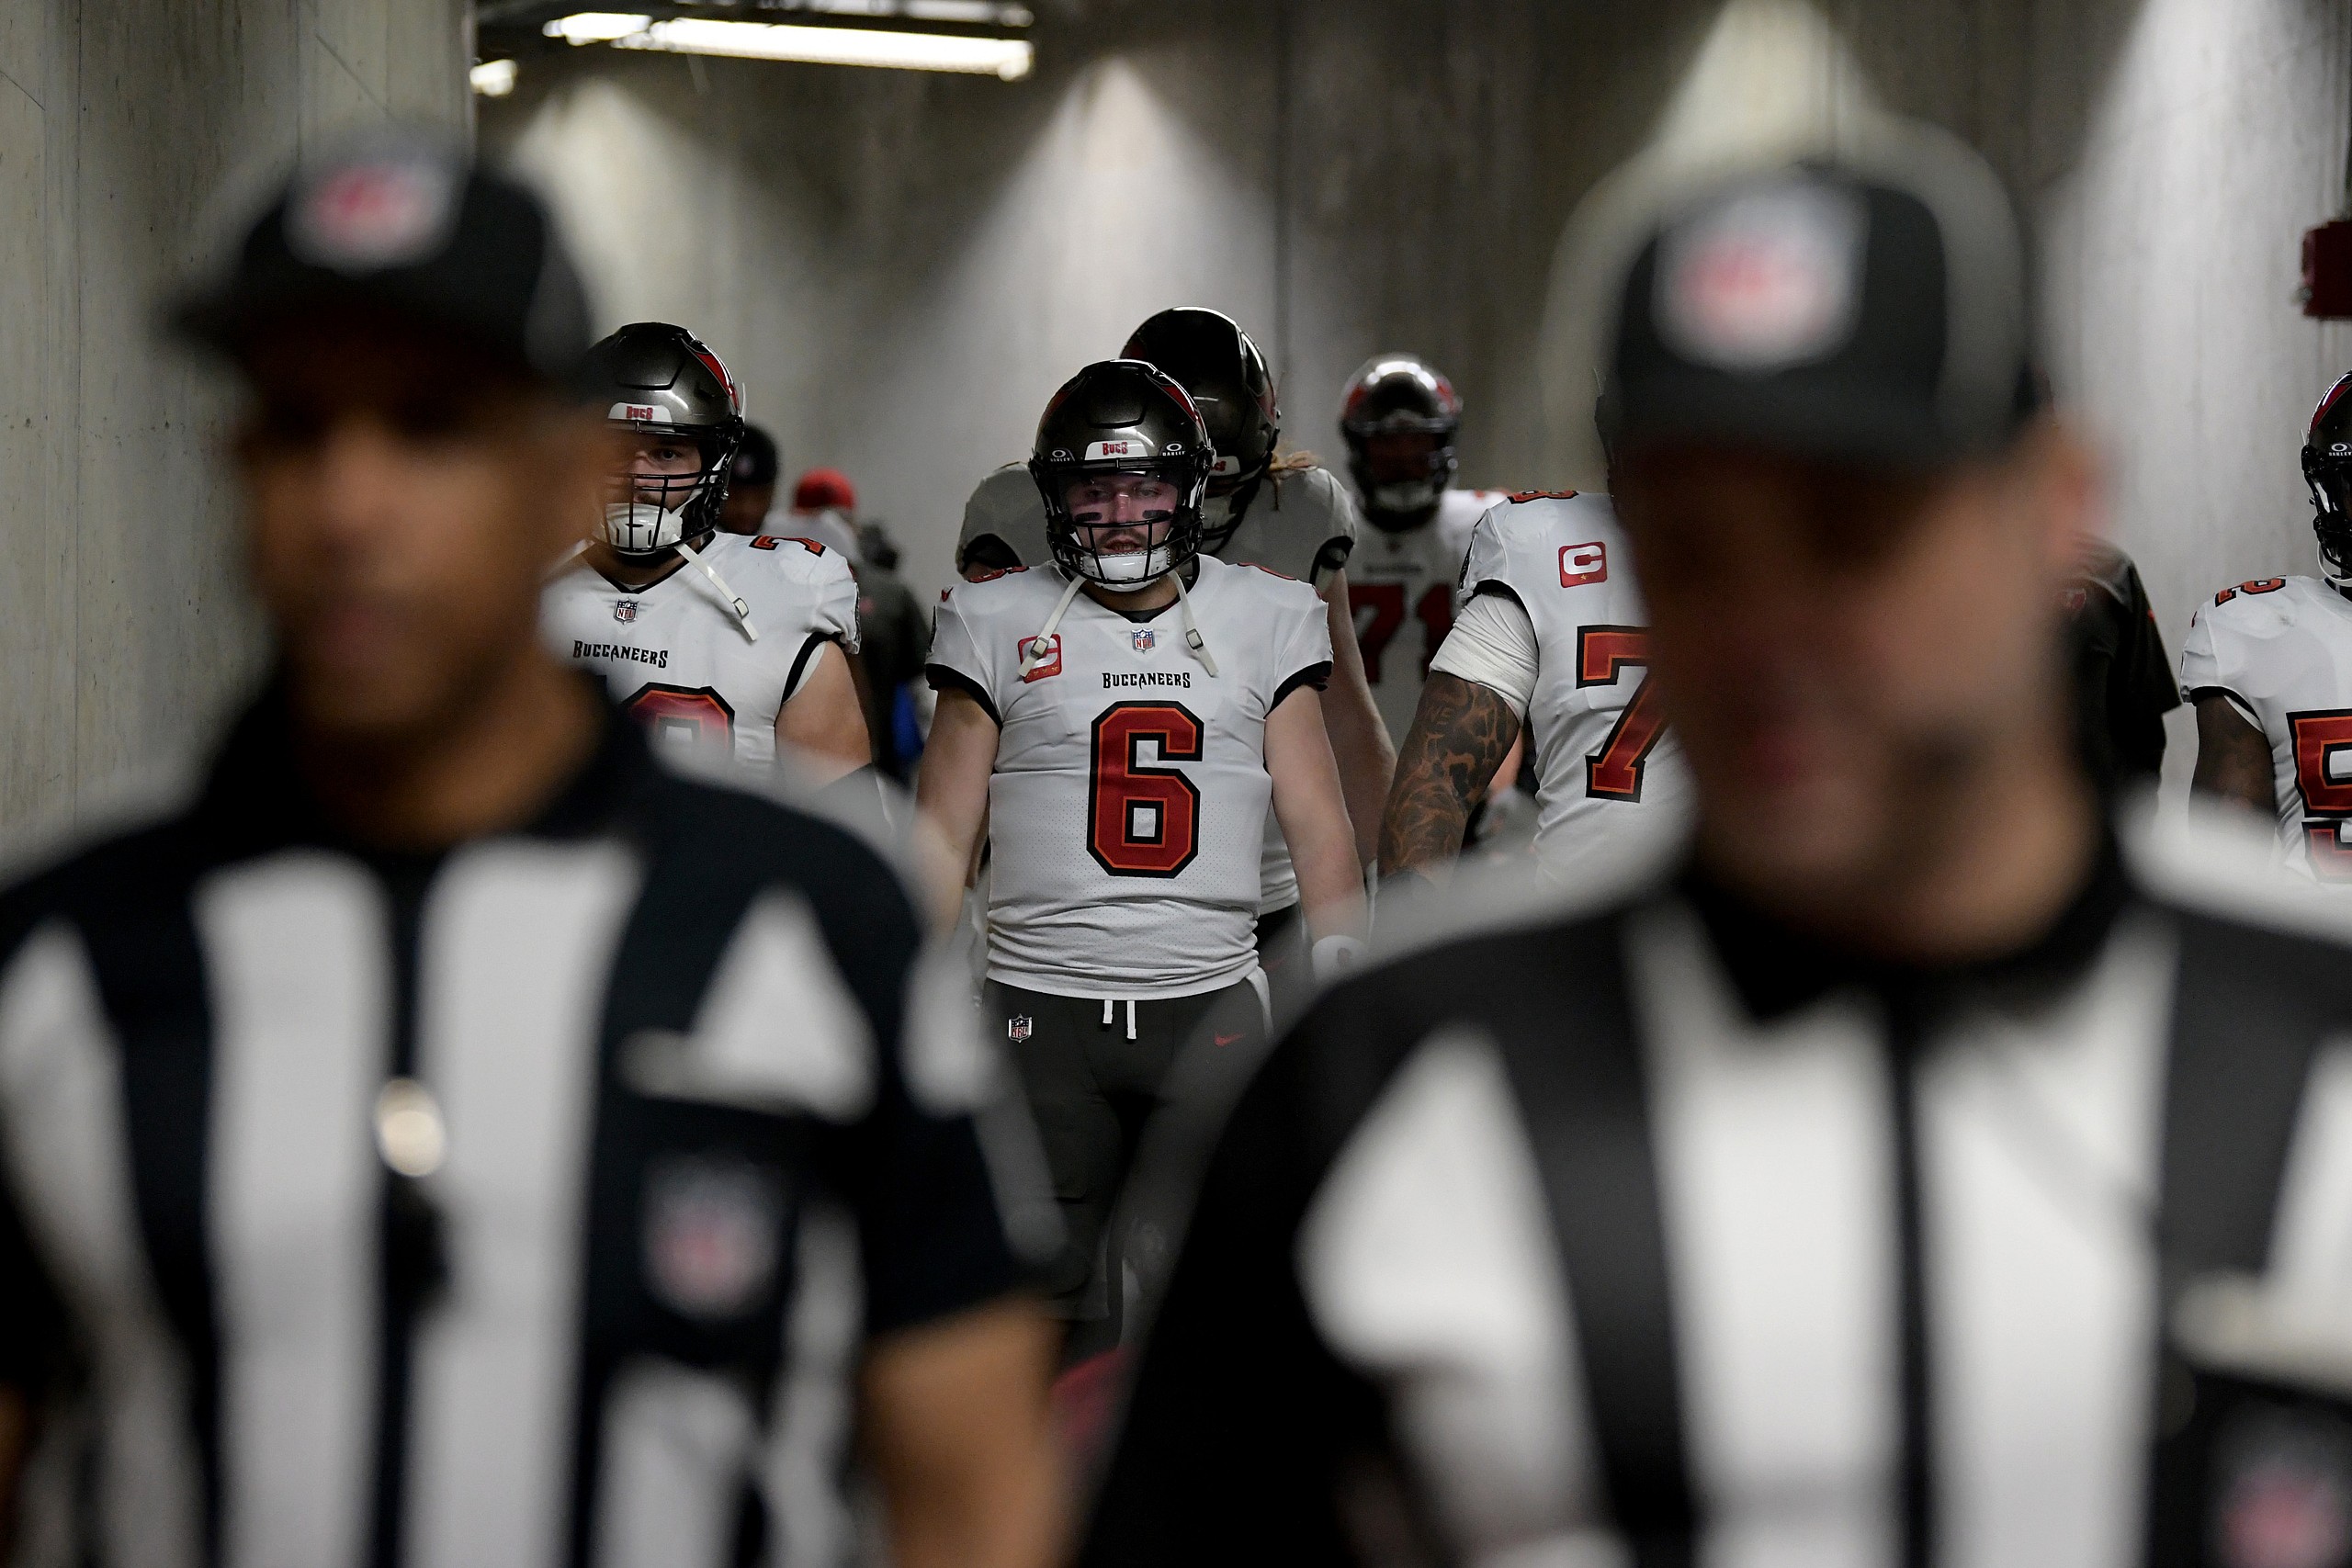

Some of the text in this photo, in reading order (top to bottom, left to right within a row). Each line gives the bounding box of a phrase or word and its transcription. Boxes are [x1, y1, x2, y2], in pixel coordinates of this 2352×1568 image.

[1102, 441, 1128, 456] BUCS
[1563, 545, 1602, 575] C
[572, 639, 669, 669] BUCCANEERS
[1102, 671, 1192, 690] BUCCANEERS
[1575, 624, 1670, 804] 7
[1086, 700, 1204, 879] 6
